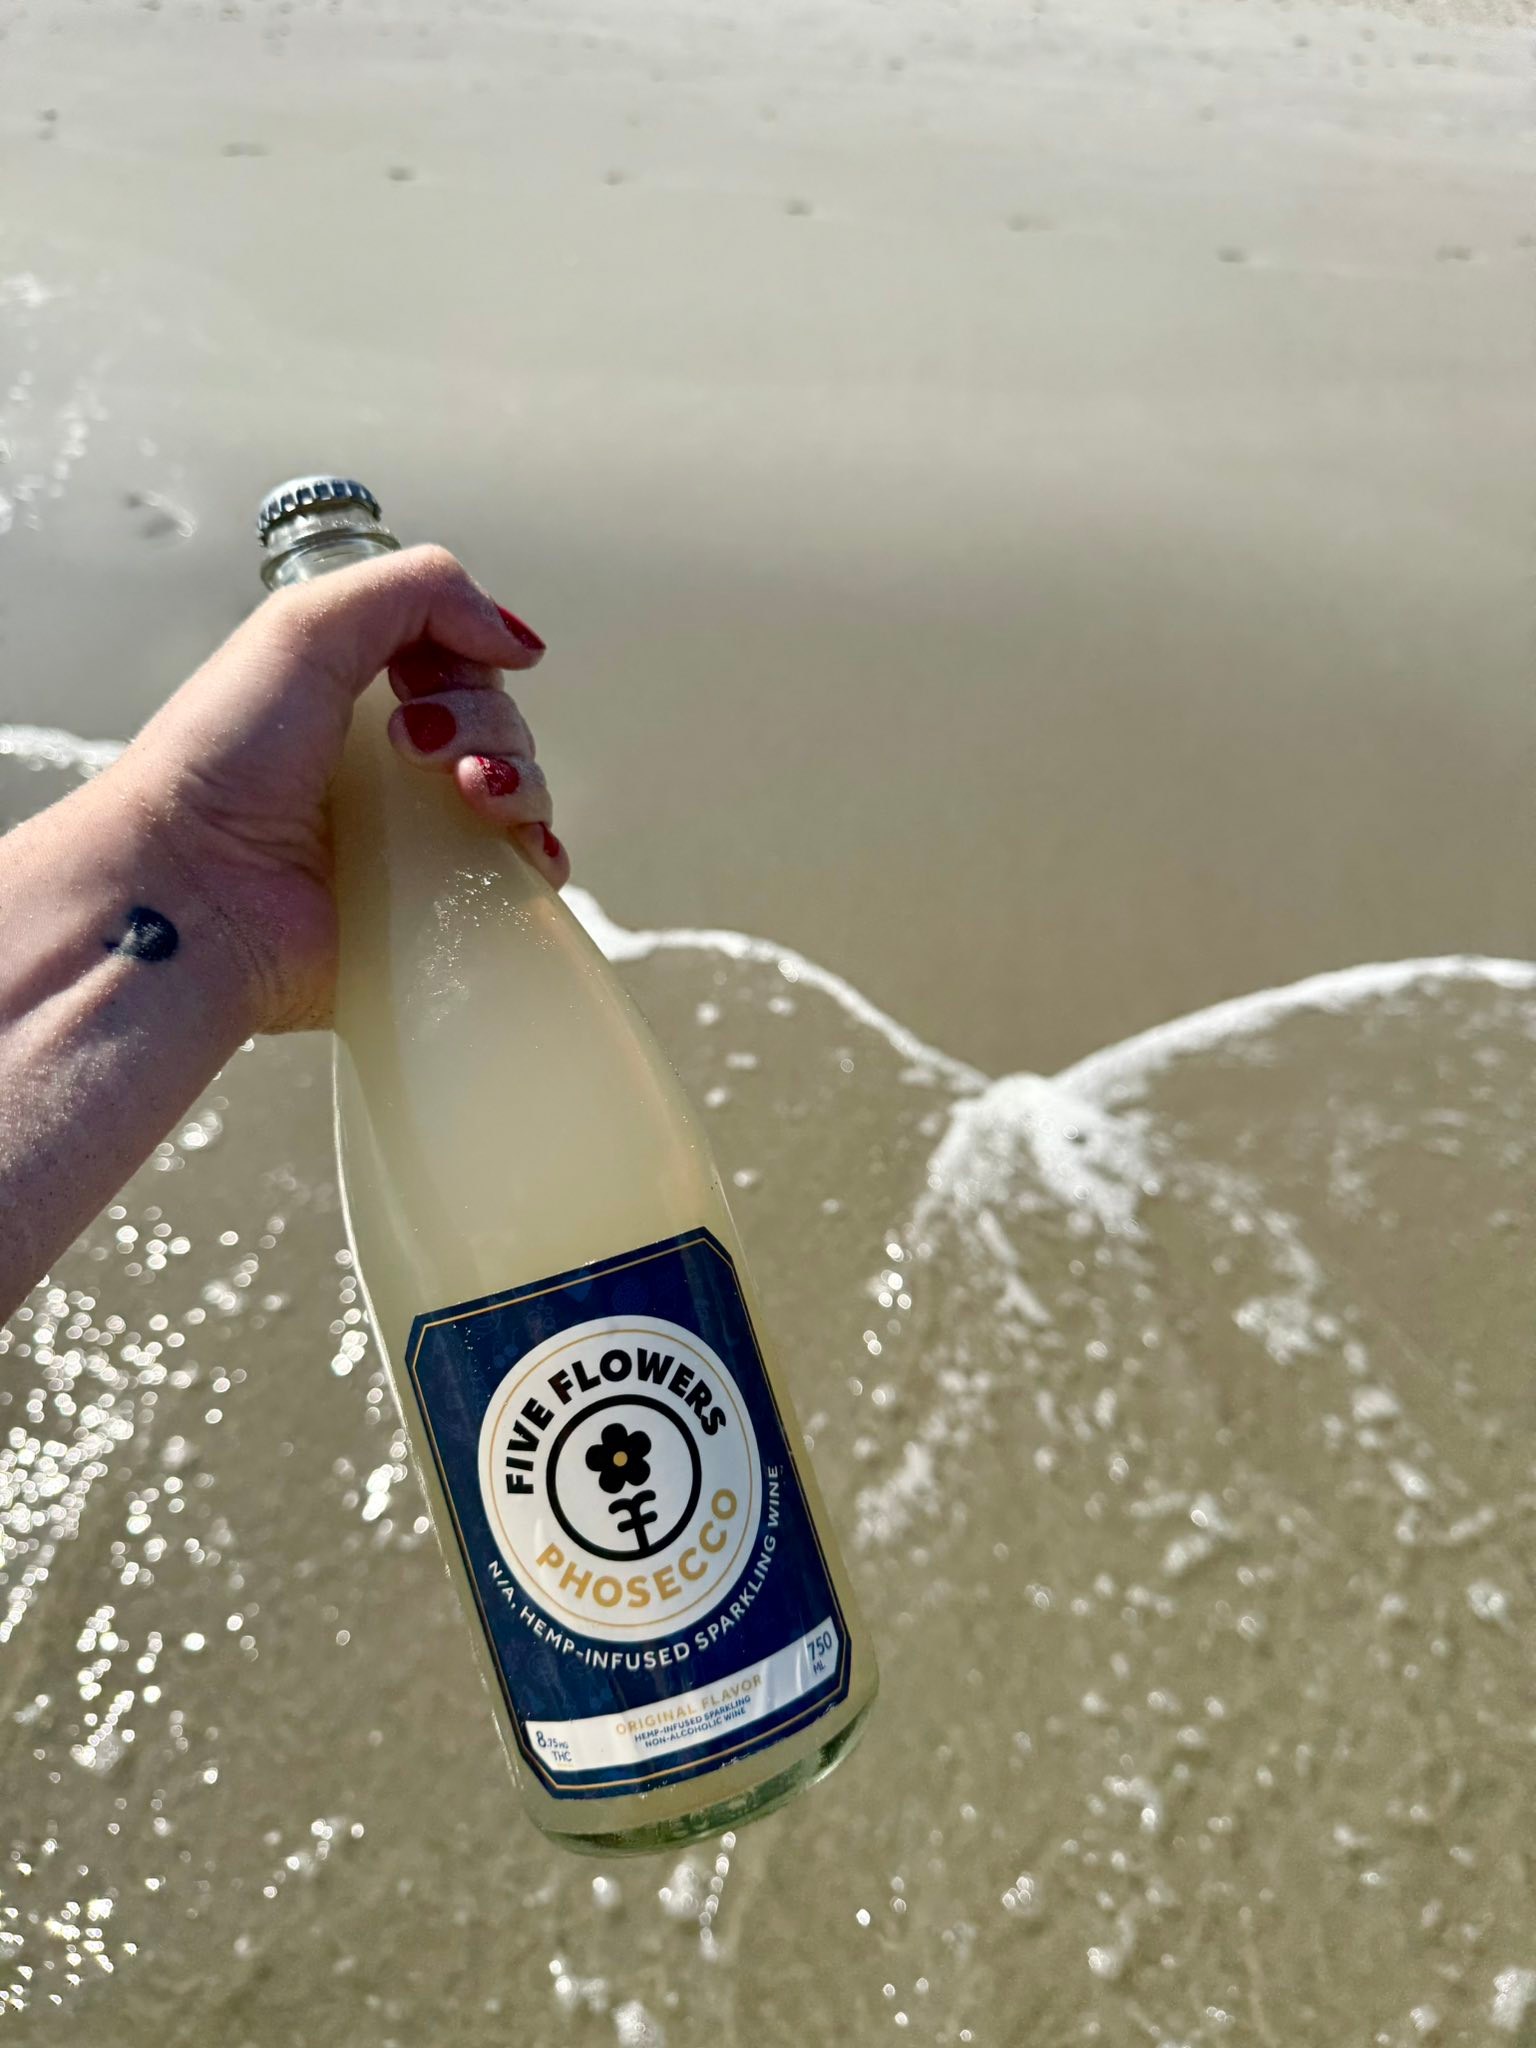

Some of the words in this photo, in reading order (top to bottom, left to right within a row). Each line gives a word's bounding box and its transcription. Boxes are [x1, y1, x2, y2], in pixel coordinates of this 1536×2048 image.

[505, 1397, 555, 1494] FIVE
[547, 1347, 727, 1436] FLOWERS
[488, 1560, 517, 1609] N/A,
[519, 1605, 690, 1671] HEMP-INFUSED
[694, 1534, 777, 1651] SPARKLING
[767, 1465, 780, 1527] WINE
[535, 1487, 738, 1608] PHOSECCO
[807, 1630, 832, 1661] 750
[813, 1659, 826, 1675] ML
[615, 1703, 697, 1736] ORIGINAL
[701, 1674, 762, 1710] FLAVOR
[634, 1715, 703, 1743] HEMP-INFUSED
[703, 1694, 752, 1721] SPARKLING
[644, 1719, 722, 1748] NON-ALCOHOLIC
[723, 1708, 746, 1723] WINE
[551, 1750, 572, 1762] THC
